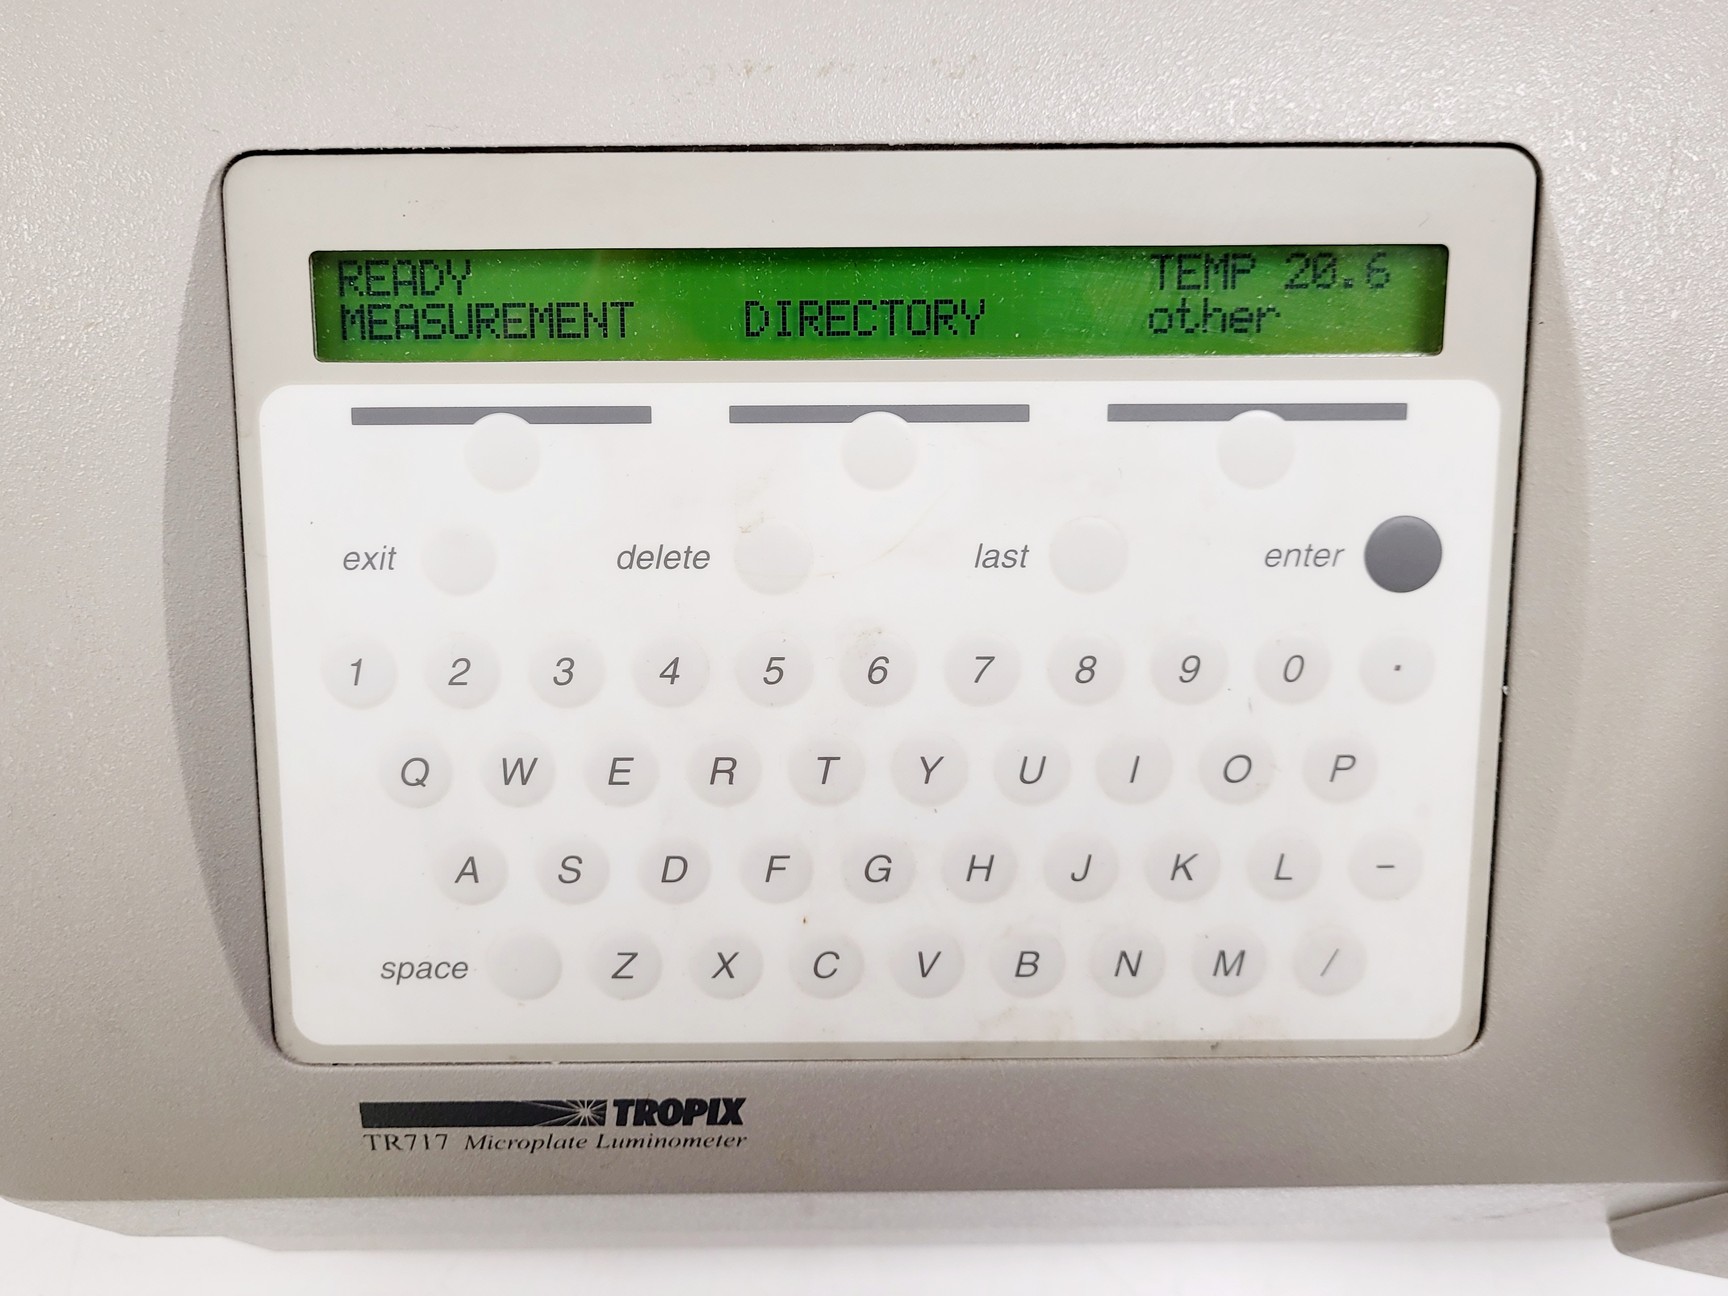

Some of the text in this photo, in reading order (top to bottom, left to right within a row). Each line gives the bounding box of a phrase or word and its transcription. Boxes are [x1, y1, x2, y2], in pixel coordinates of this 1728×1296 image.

[338, 252, 1391, 297] READY TEMP 20.6
[341, 297, 1281, 341] MEASUREMENT DIRECTORY other
[343, 543, 1345, 570] exit delete last enter
[350, 657, 363, 687] 1
[447, 657, 472, 686] 2
[552, 657, 575, 687] 3
[658, 656, 681, 685] 4
[762, 656, 786, 686] 5
[867, 655, 890, 685] 6
[973, 655, 996, 684] 7
[1074, 655, 1098, 684] 8
[1178, 654, 1201, 684] 9
[1283, 654, 1305, 683] 0
[400, 754, 1357, 788] Q W E R T Y U I O P
[454, 855, 480, 884] A
[557, 855, 583, 885] S
[660, 855, 689, 884] D
[764, 854, 791, 883] F
[864, 854, 893, 884] G
[965, 854, 995, 882] H
[1070, 853, 1093, 883] J
[1170, 853, 1199, 881] K
[1273, 853, 1293, 881] L
[380, 949, 1339, 986] space Z X C V B N M /
[614, 1097, 748, 1127] TROPIX
[363, 1133, 748, 1155] TR717 Microplate Luminometer
